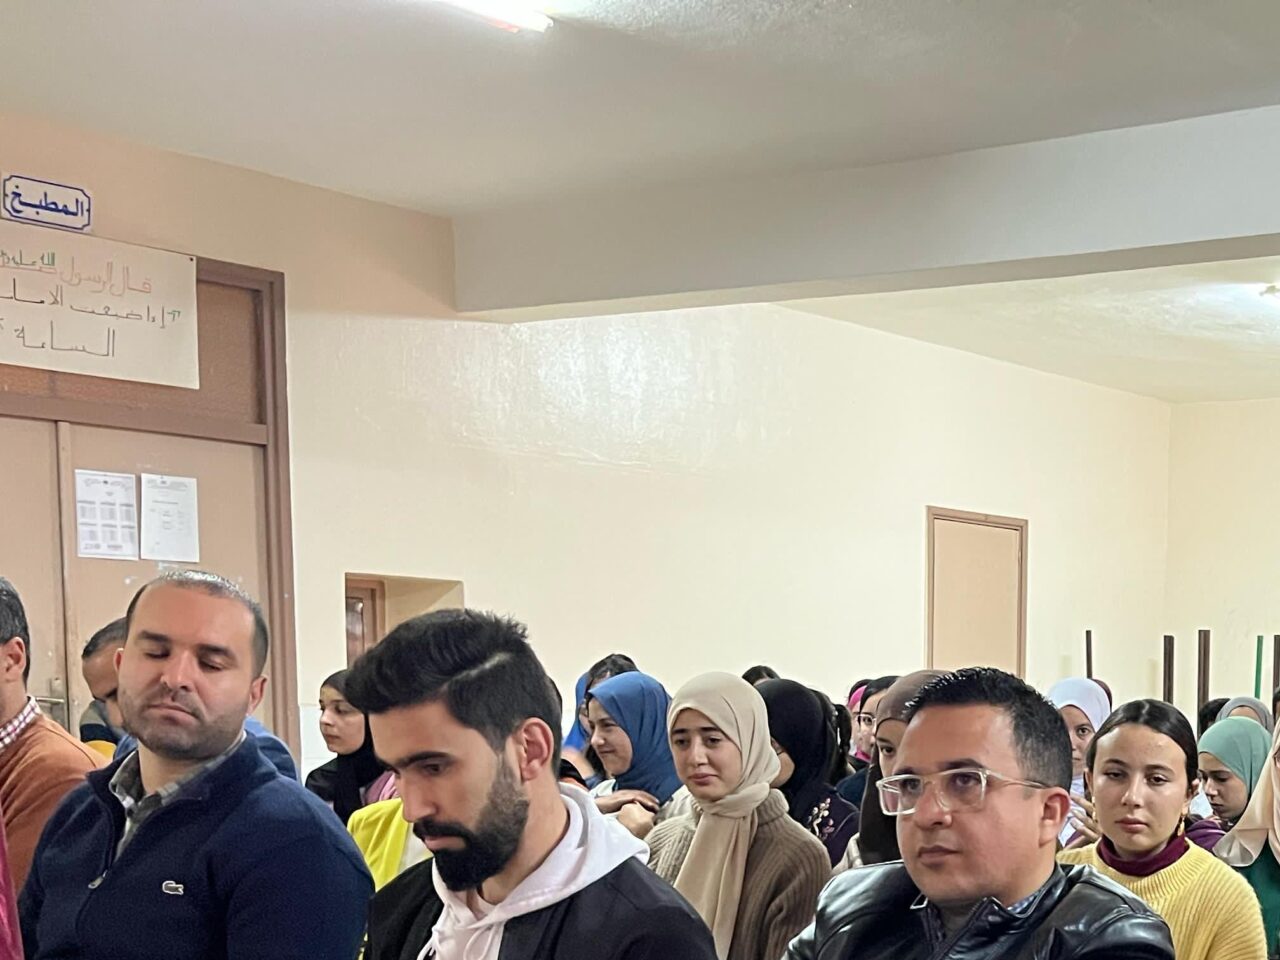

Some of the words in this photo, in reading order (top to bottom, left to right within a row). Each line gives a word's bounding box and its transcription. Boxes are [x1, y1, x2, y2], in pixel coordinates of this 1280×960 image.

[10, 184, 85, 218] المطبخ
[61, 256, 113, 294] الرسول
[109, 265, 152, 297] قال
[70, 304, 142, 321] ضيعت
[14, 319, 115, 358] الساعة
